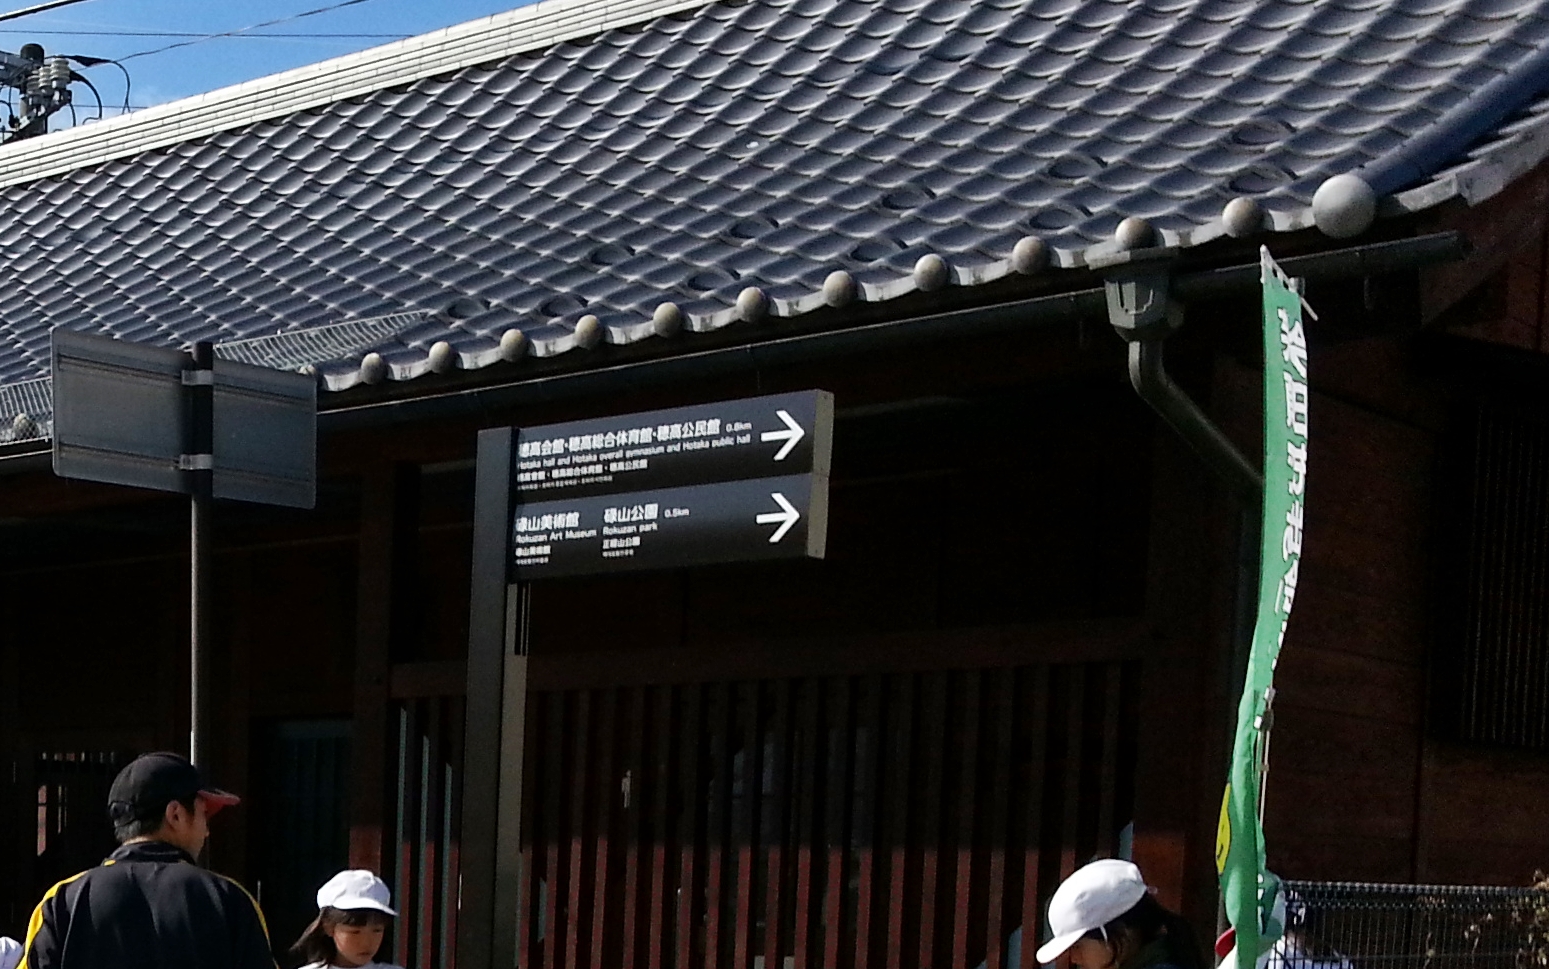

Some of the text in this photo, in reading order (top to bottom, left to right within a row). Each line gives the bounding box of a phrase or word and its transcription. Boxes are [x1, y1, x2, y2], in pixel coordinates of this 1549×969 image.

[604, 503, 658, 524] 碌山公園
[550, 531, 563, 541] Art
[565, 529, 597, 540] Museum
[603, 522, 658, 536] Rokuzan park
